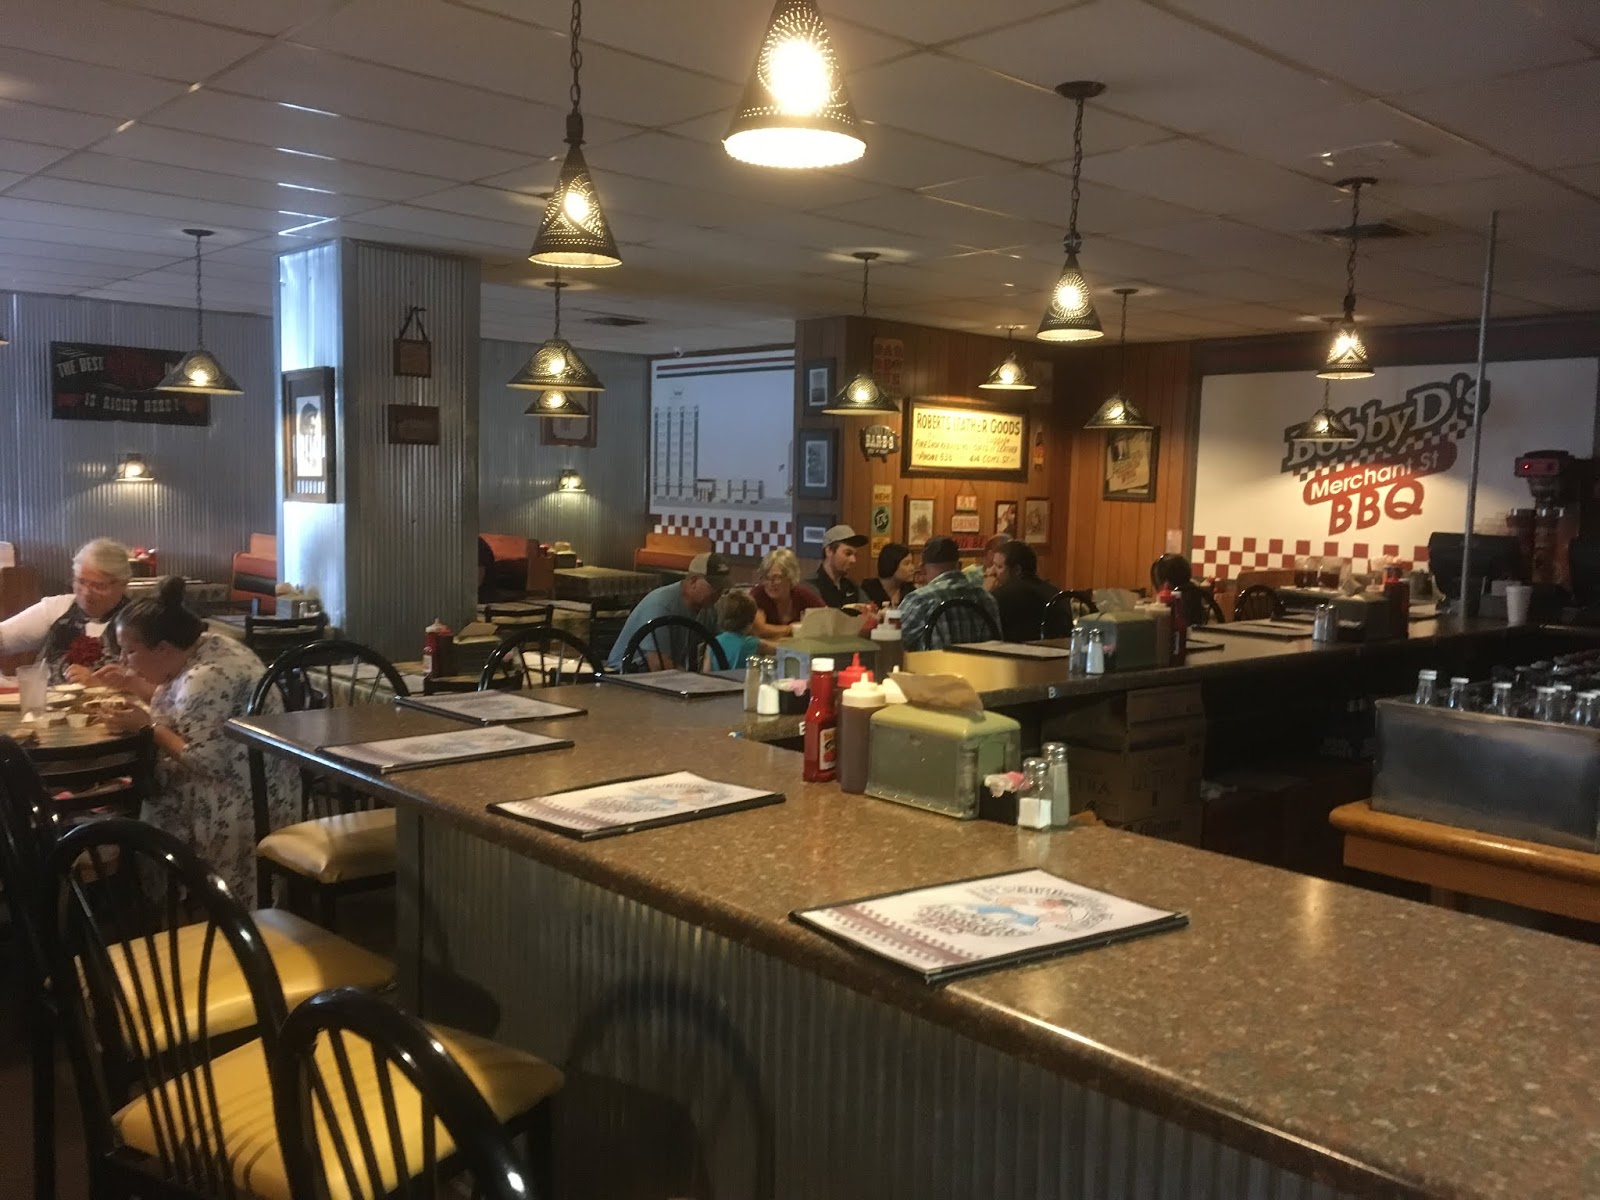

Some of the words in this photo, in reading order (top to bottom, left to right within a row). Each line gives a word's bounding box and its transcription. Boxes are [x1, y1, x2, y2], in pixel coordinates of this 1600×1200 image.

[57, 360, 78, 378] THE
[79, 356, 105, 373] BEST
[103, 396, 138, 412] RIGHT
[917, 412, 951, 431] ROBERTS
[990, 418, 1021, 436] GOODS
[1310, 456, 1412, 500] Merchant
[1419, 451, 1439, 471] St
[957, 496, 975, 508] EAT
[1328, 479, 1425, 537] BBQ
